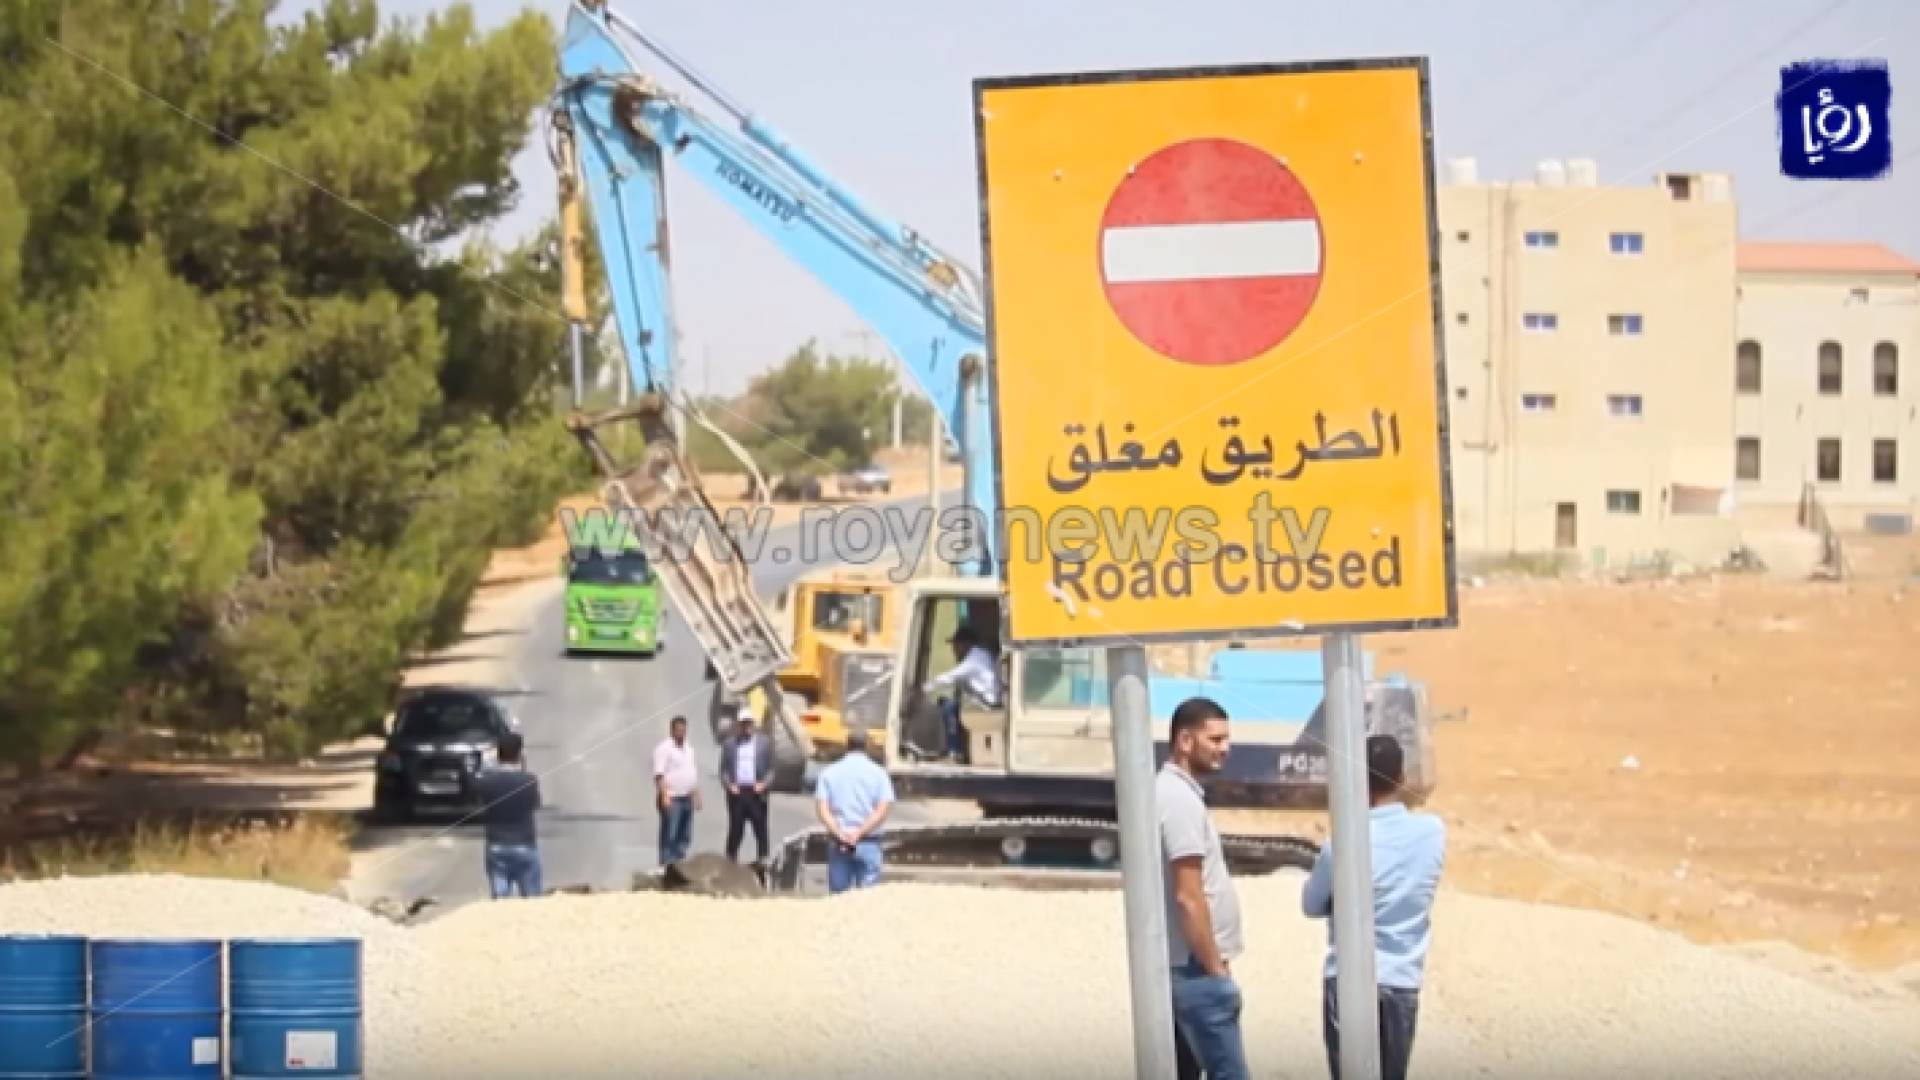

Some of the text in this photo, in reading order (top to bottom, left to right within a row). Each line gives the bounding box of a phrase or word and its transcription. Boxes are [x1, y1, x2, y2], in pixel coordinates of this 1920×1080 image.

[1046, 407, 1400, 493] الطريق مغلق
[1051, 535, 1400, 603] Road Closed
